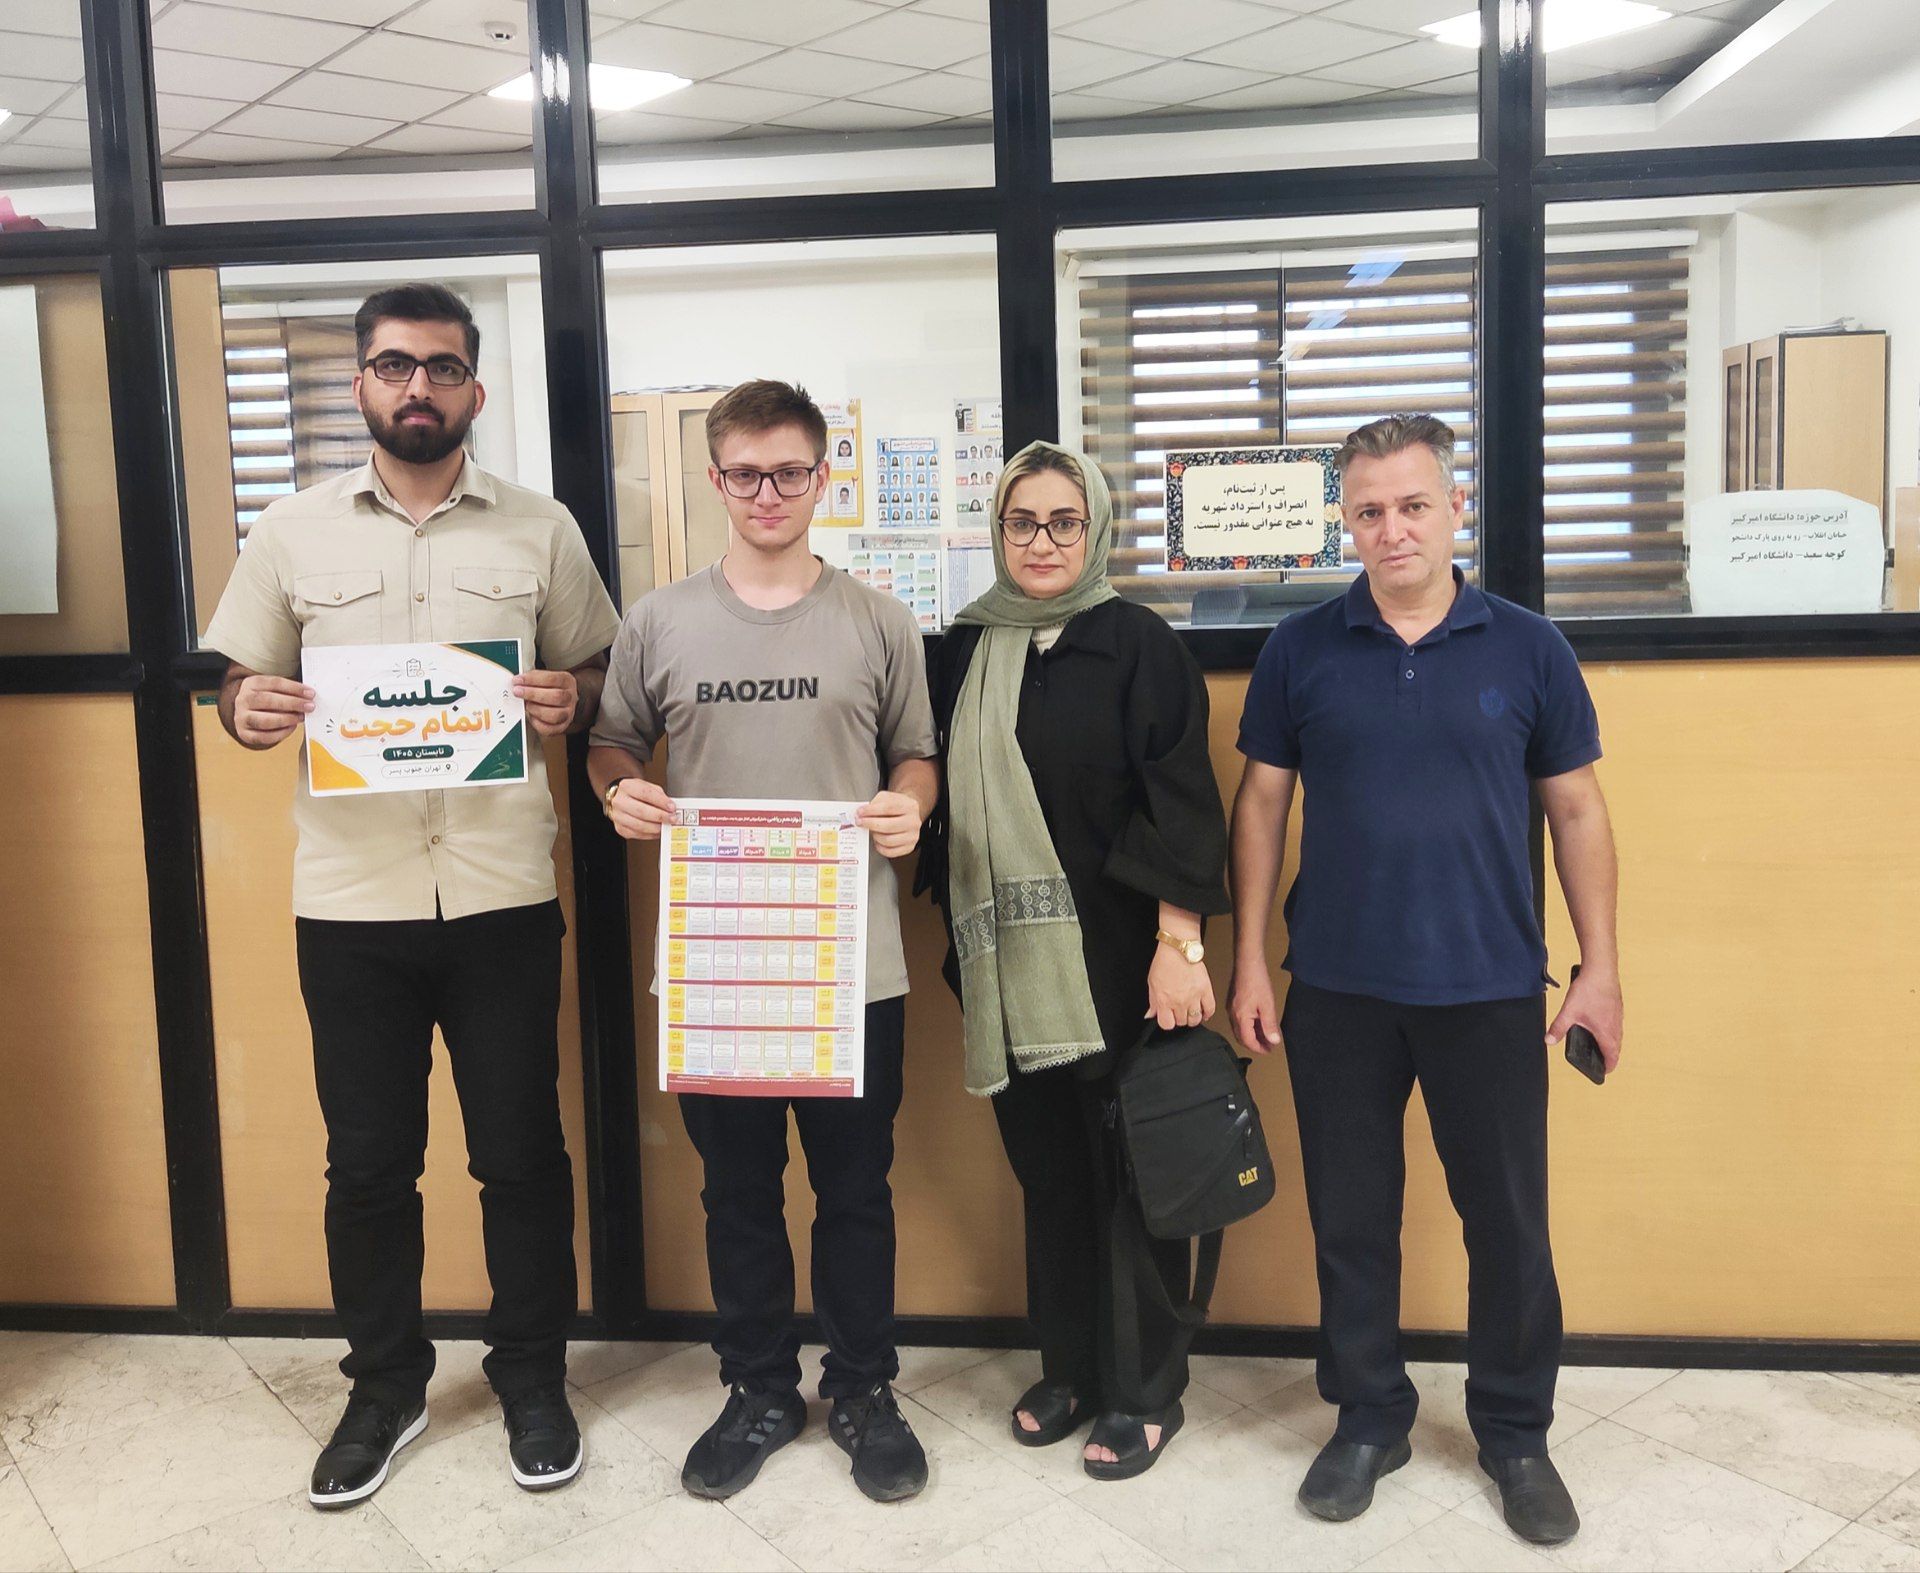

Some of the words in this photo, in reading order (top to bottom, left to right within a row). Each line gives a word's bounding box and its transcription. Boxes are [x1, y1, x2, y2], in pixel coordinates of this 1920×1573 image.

[1259, 484, 1267, 496] از
[1270, 485, 1286, 496] پس
[1202, 502, 1228, 514] شهریه
[1230, 500, 1264, 514] استرداد
[1266, 504, 1272, 514] و
[1274, 499, 1308, 512] انصراف
[1764, 512, 1794, 522] دانشگاه
[1823, 510, 1848, 522] آدرس
[1224, 518, 1250, 532] مقدور
[1252, 518, 1283, 530] عنوانی
[1286, 519, 1303, 530] هیچ
[1305, 518, 1314, 528] به
[1754, 534, 1770, 542] پارک
[1827, 532, 1848, 541] خیابان
[1763, 550, 1794, 560] دانشگاه
[1824, 549, 1846, 561] کوچه
[363, 678, 468, 712] جلسه
[696, 676, 819, 704] BAOZUN
[340, 717, 416, 744] حجت
[421, 708, 492, 742] اتمام
[392, 749, 413, 758] ۱۴۰۵
[415, 747, 445, 758] تابستان
[424, 764, 442, 772] تهران
[1238, 1166, 1258, 1187] CAT
